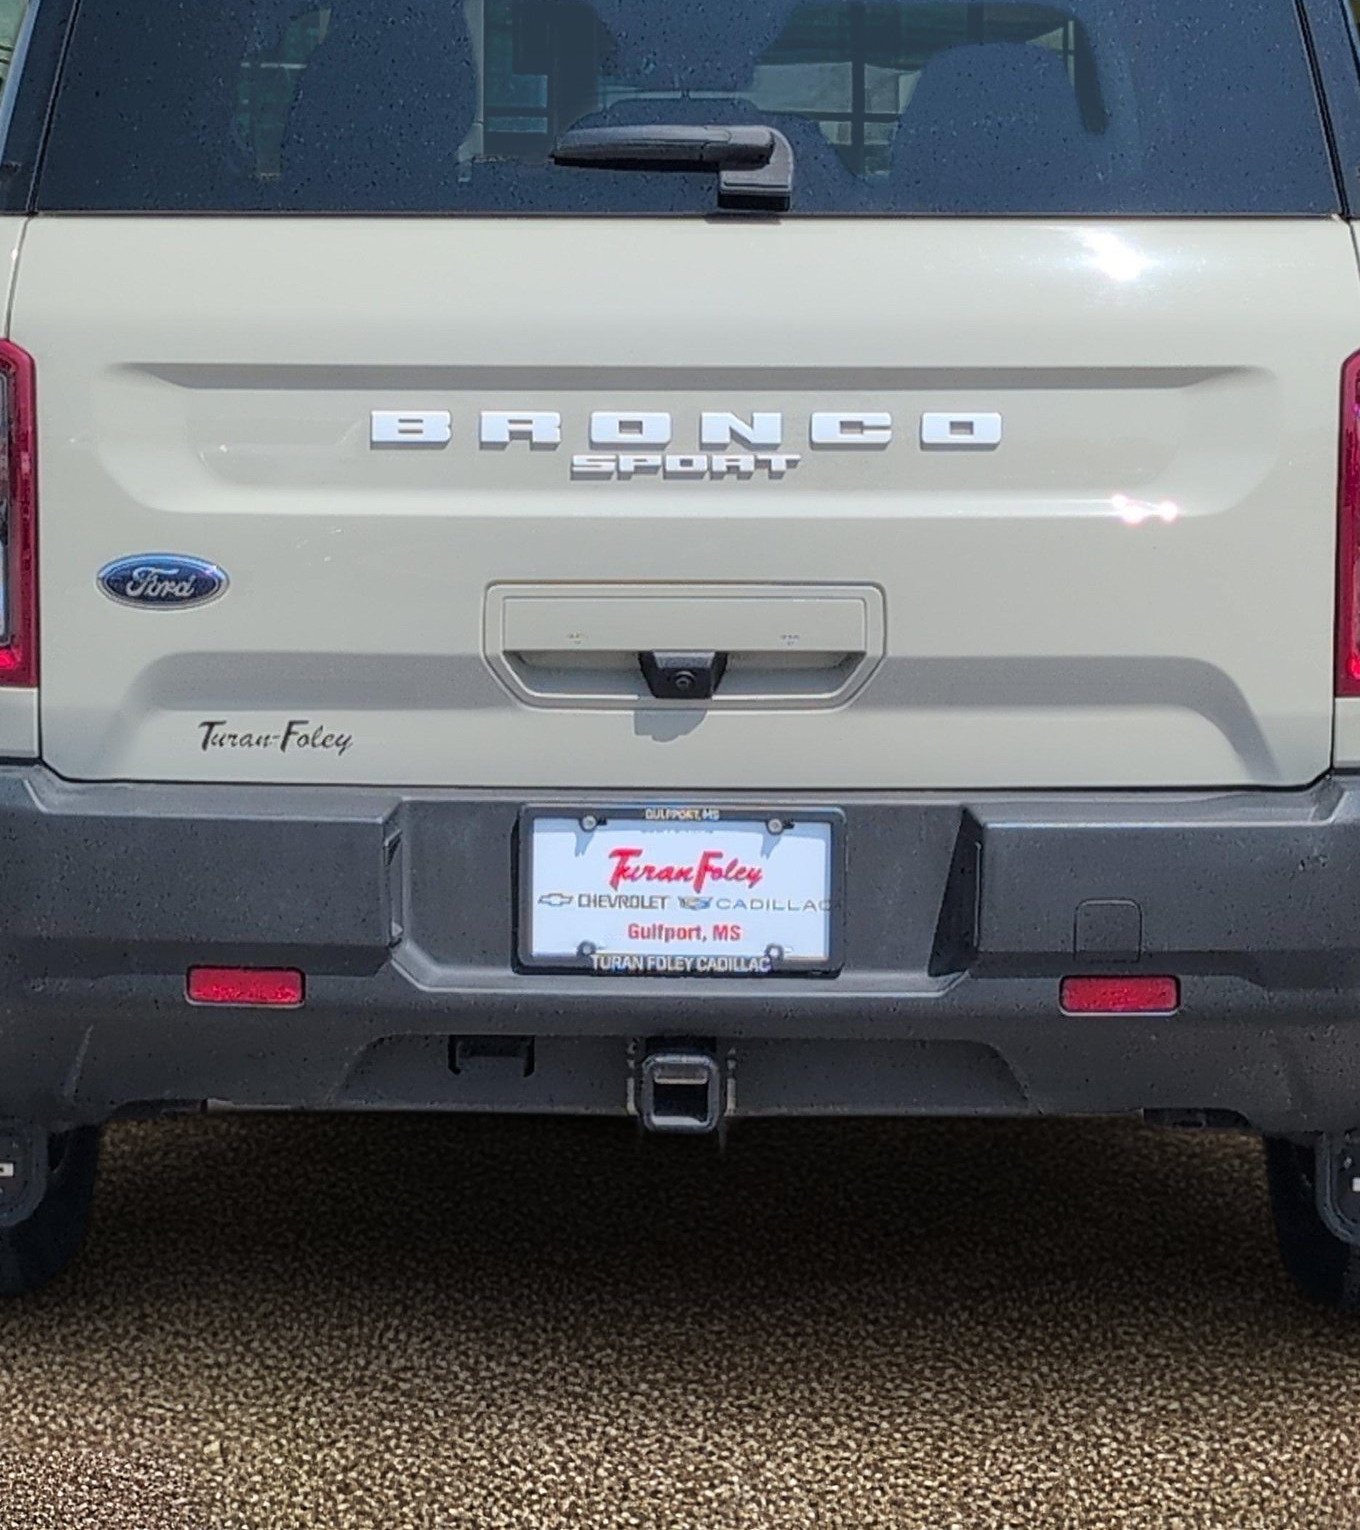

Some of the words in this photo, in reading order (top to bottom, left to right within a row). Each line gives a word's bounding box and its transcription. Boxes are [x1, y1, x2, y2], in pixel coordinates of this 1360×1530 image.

[370, 410, 1003, 450] BRONCO
[571, 454, 801, 480] SPORT
[125, 566, 196, 598] Ford
[693, 851, 763, 894] Foley
[578, 894, 668, 910] CHEVROLET
[628, 923, 707, 943] Gulfport,
[712, 924, 741, 941] MS
[591, 955, 644, 970] TURAN
[647, 956, 695, 971] FOLEY
[696, 957, 771, 972] CADILLAC
